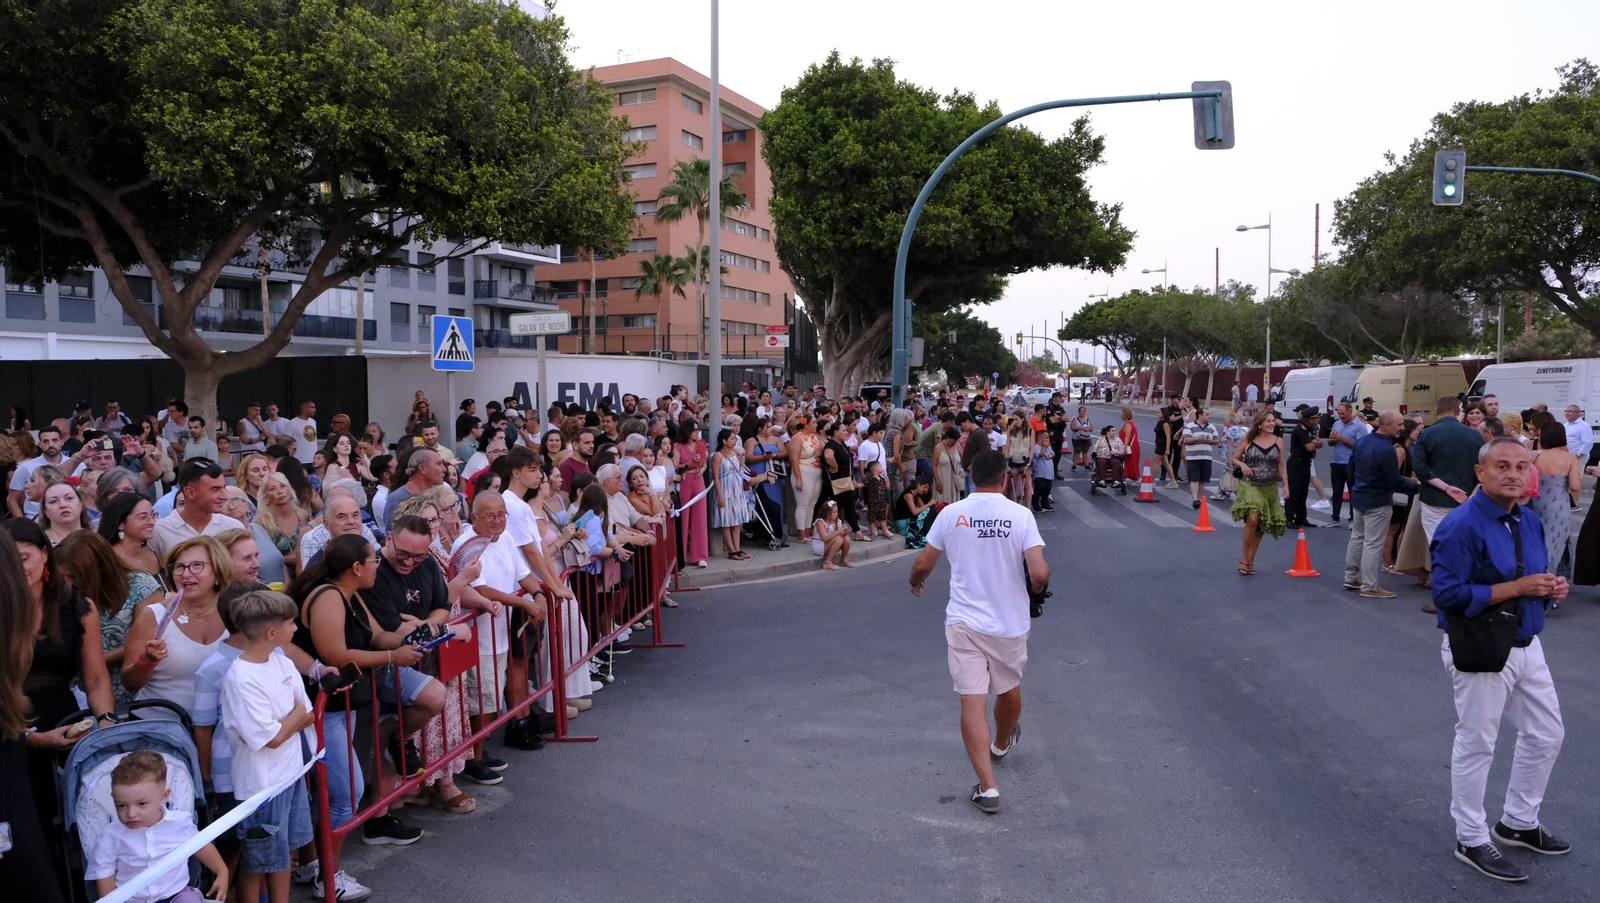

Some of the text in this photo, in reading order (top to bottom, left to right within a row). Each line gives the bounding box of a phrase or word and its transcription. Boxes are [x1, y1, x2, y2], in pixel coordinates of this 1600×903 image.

[519, 322, 566, 332] GALAN DE NOCHE
[512, 382, 622, 415] AEMA
